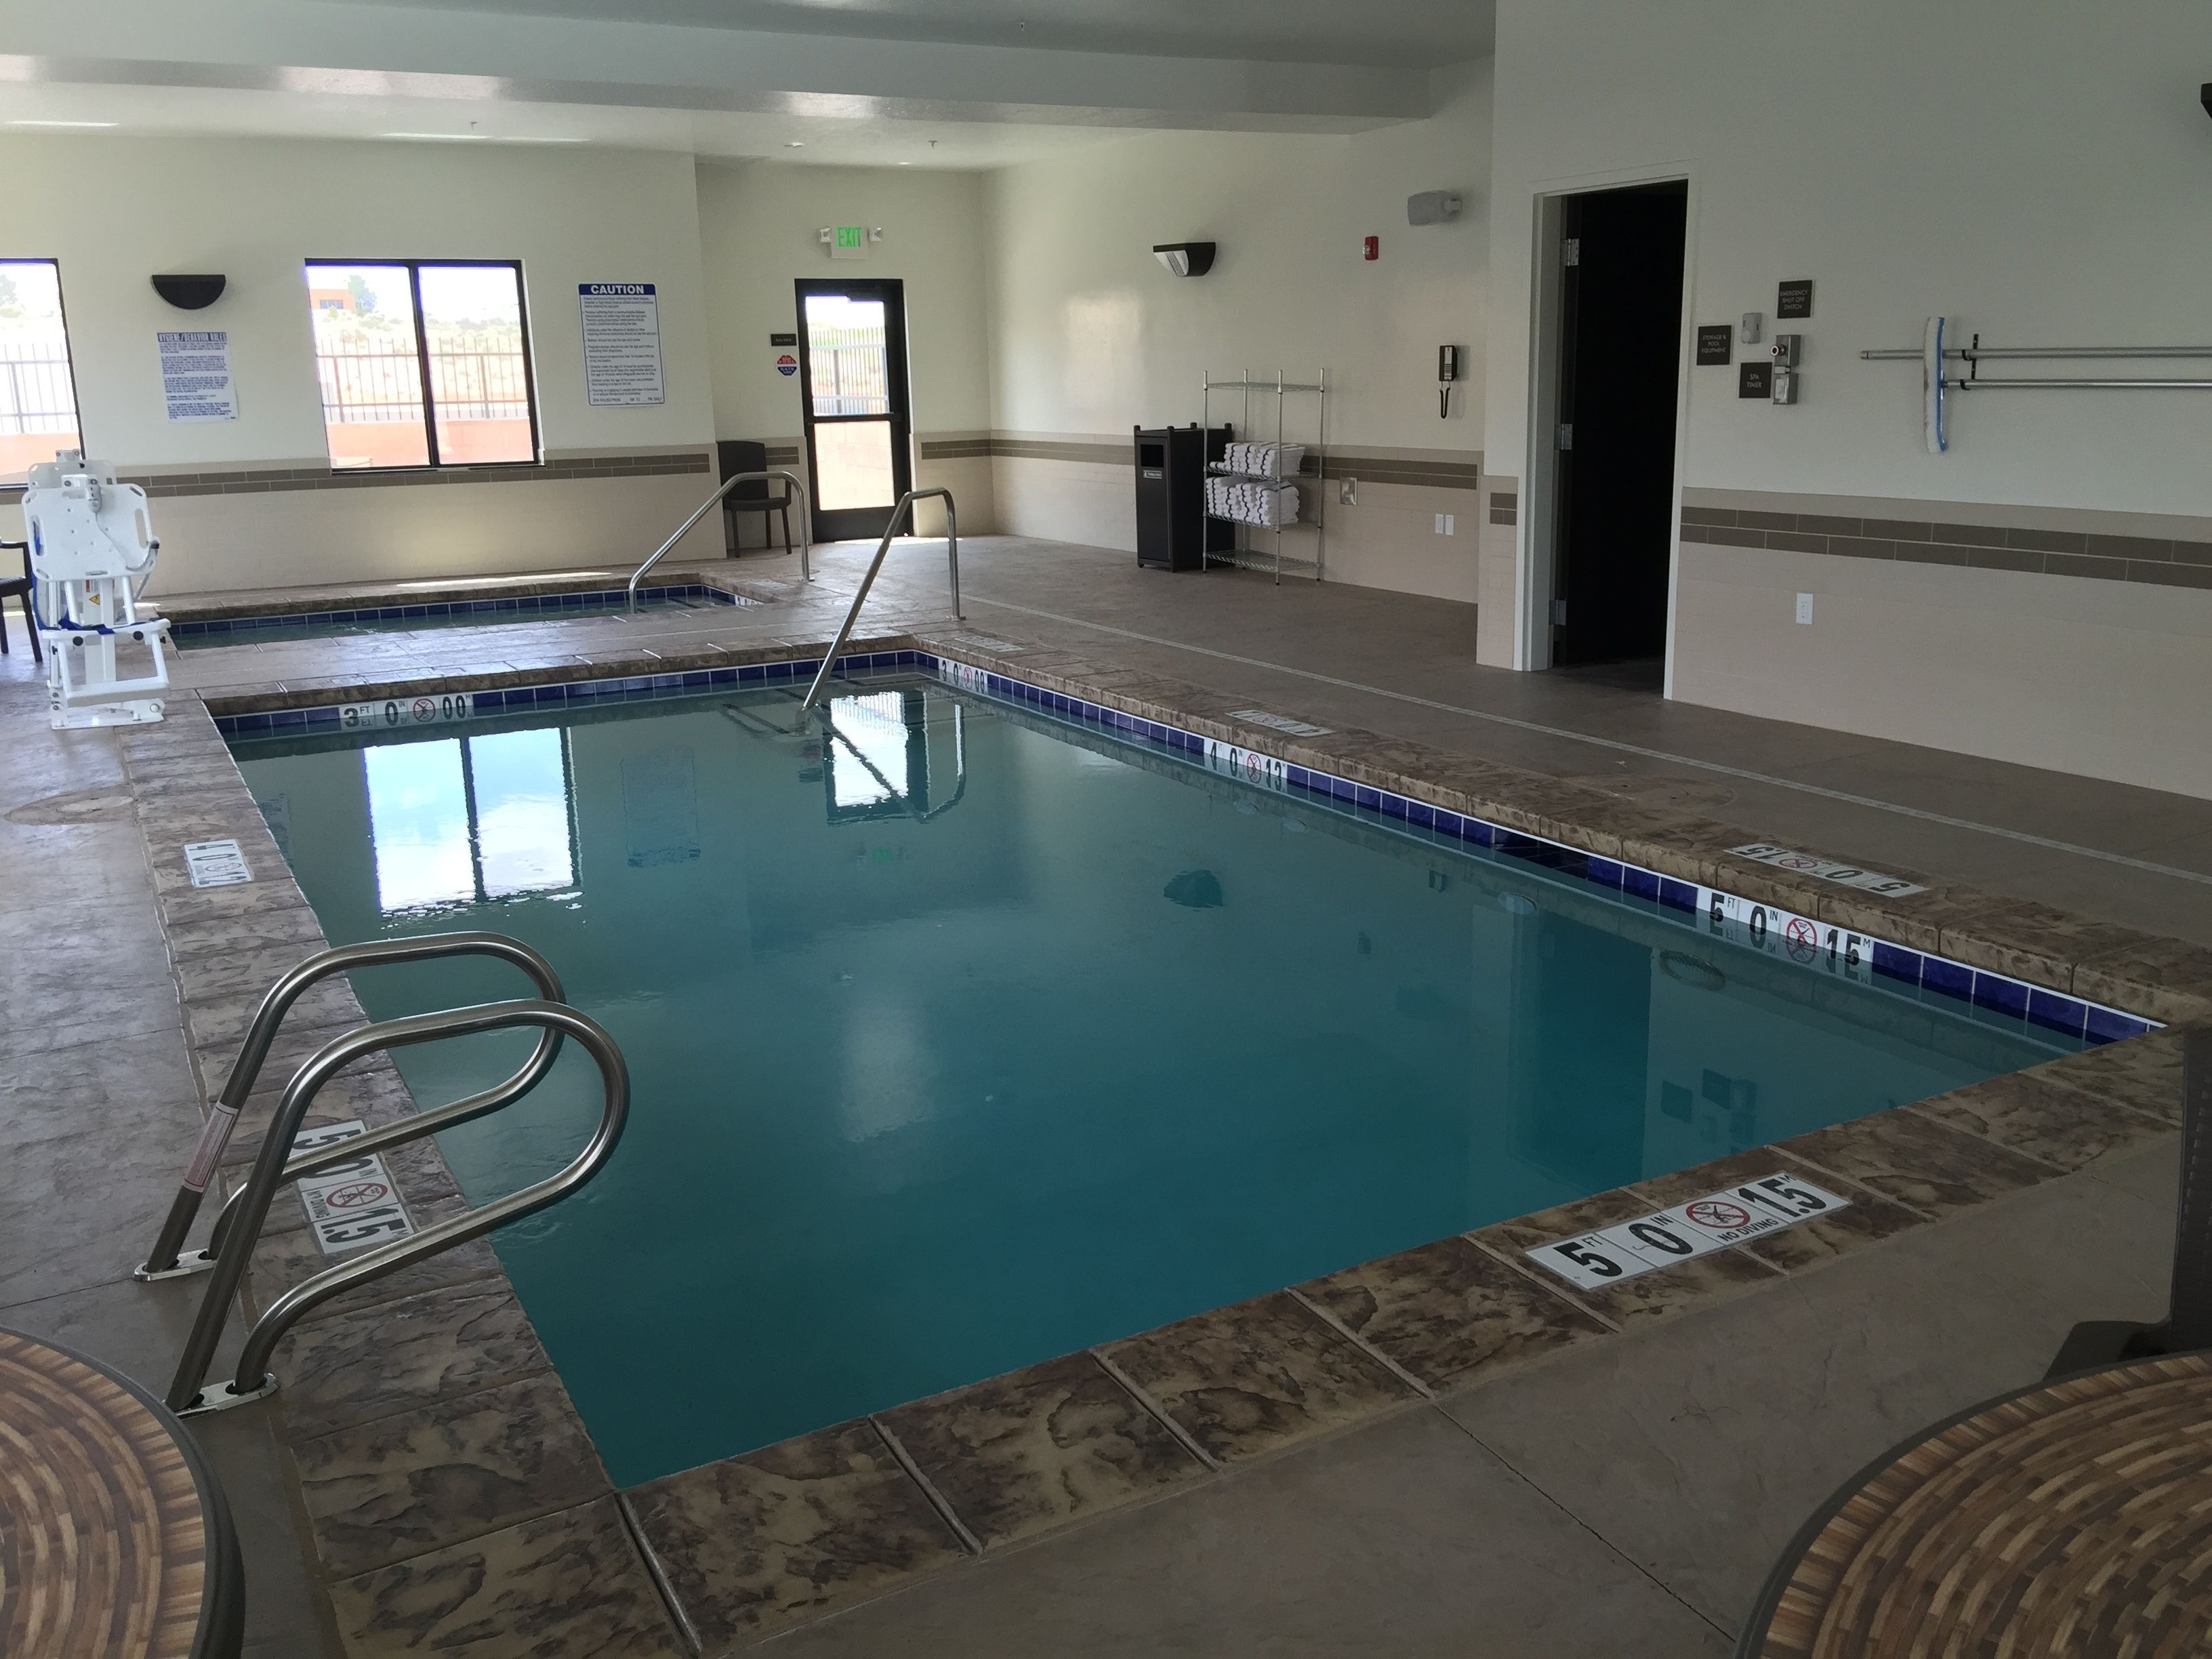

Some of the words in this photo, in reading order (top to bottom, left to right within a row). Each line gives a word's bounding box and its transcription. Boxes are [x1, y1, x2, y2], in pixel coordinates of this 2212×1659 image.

[837, 227, 861, 247] EXIT
[591, 285, 644, 294] CAUTION
[359, 705, 370, 714] FT
[385, 701, 398, 725] 0
[1826, 870, 1863, 878] 0
[1868, 882, 1911, 893] 5
[1709, 893, 1725, 922] 5
[1728, 897, 1736, 909] FT
[1749, 905, 1767, 947] 0
[1769, 910, 1778, 922] IN
[1864, 938, 1870, 947] M
[292, 1129, 362, 1150] 5
[1780, 1173, 1799, 1183] M
[310, 1198, 330, 1218] DIVING
[1738, 1179, 1827, 1218] 1.5
[321, 1208, 406, 1243] 1.5
[1650, 1214, 1673, 1227] IN
[1717, 1231, 1740, 1242] NO
[1736, 1218, 1779, 1236] DIVING
[1582, 1235, 1603, 1248] FT
[1628, 1223, 1694, 1255] 0
[1553, 1242, 1623, 1277] 5
